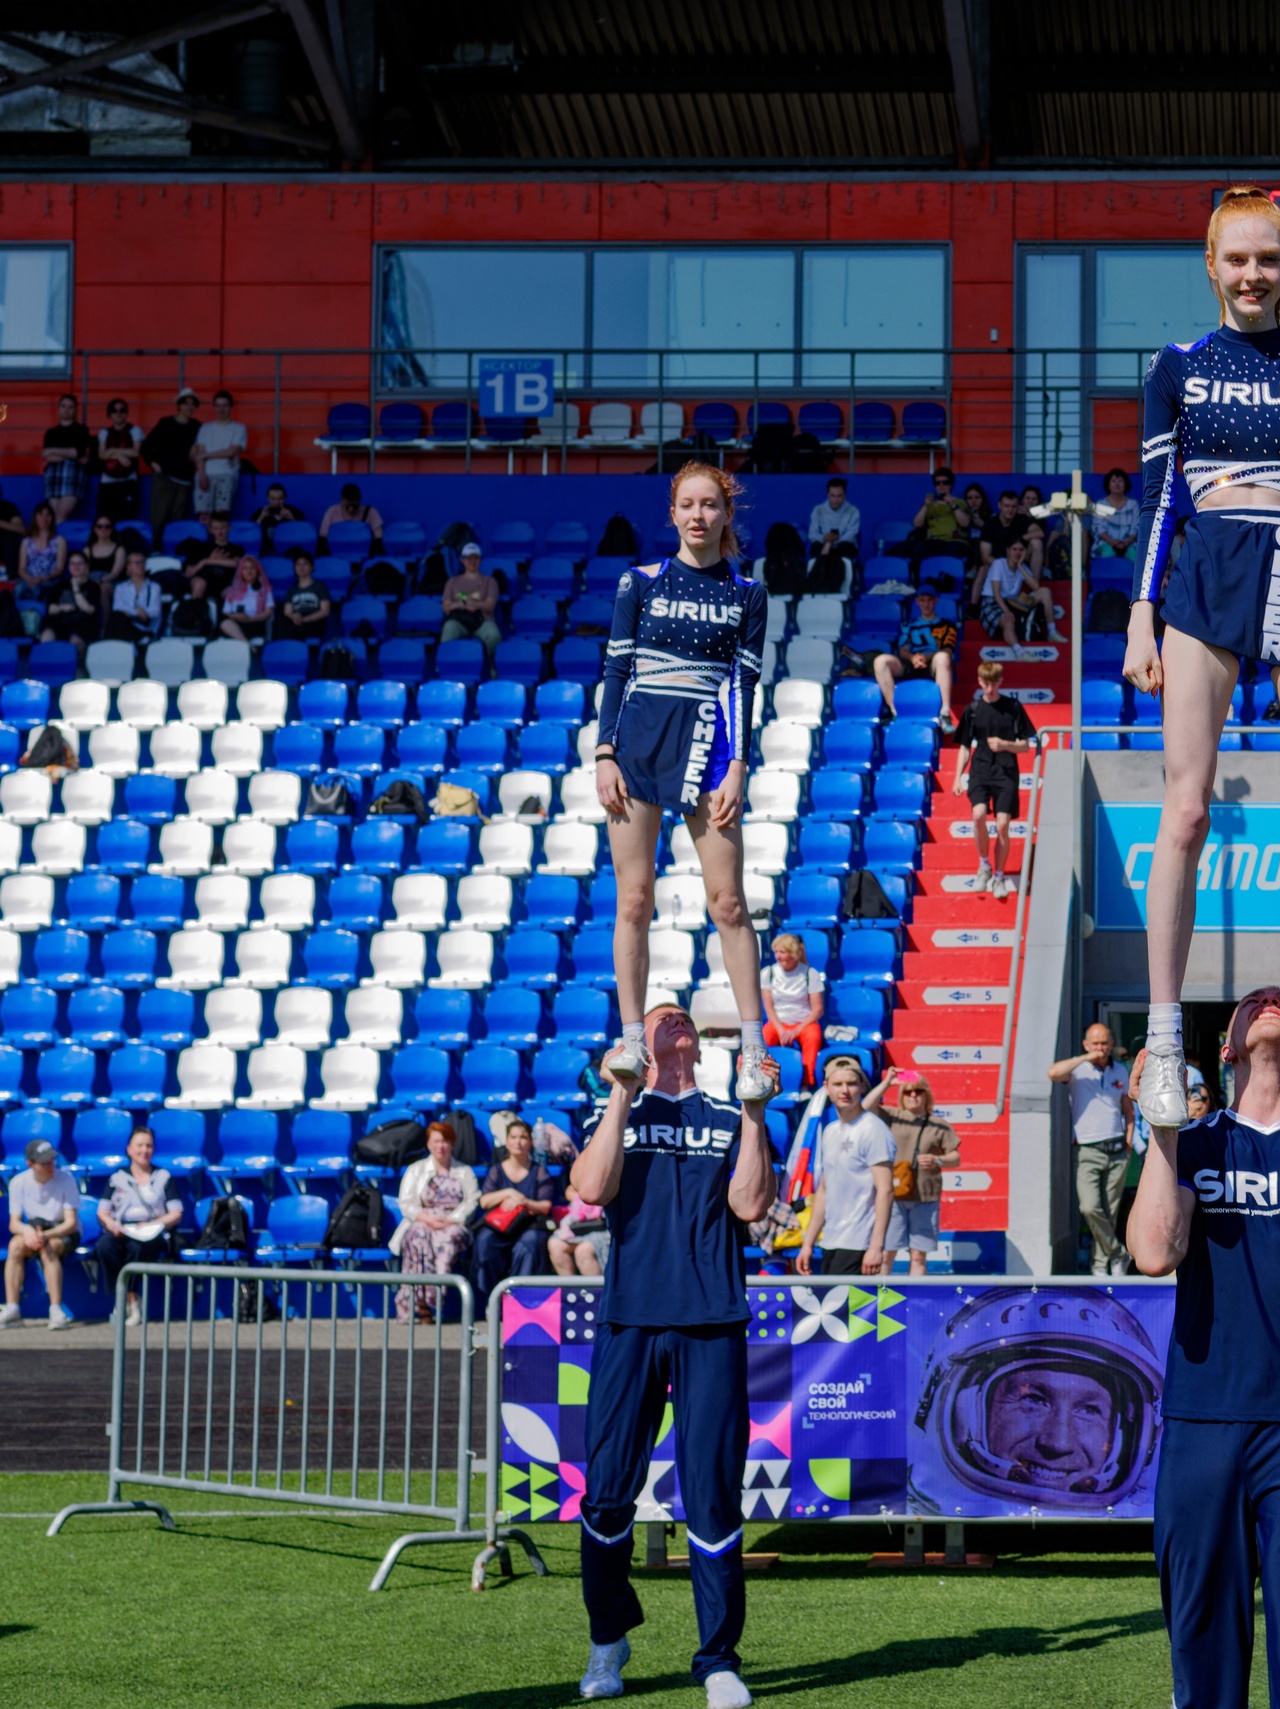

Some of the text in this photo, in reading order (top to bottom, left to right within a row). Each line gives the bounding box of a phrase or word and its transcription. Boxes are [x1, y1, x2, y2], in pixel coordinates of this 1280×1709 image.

[486, 373, 548, 413] 1В
[650, 597, 743, 627] SIRIUS
[680, 702, 717, 806] CHEER
[992, 933, 999, 942] 6
[985, 992, 992, 1000] 5
[974, 1050, 982, 1060] 4
[966, 1108, 973, 1118] 3
[623, 1125, 733, 1149] SIRIUS
[955, 1176, 962, 1186] 2
[808, 1380, 865, 1395] СОЗДАЙ
[808, 1395, 847, 1409] СВОЙ
[808, 1409, 896, 1420] ТЕХНОЛОГИЧЕСКИЙ
